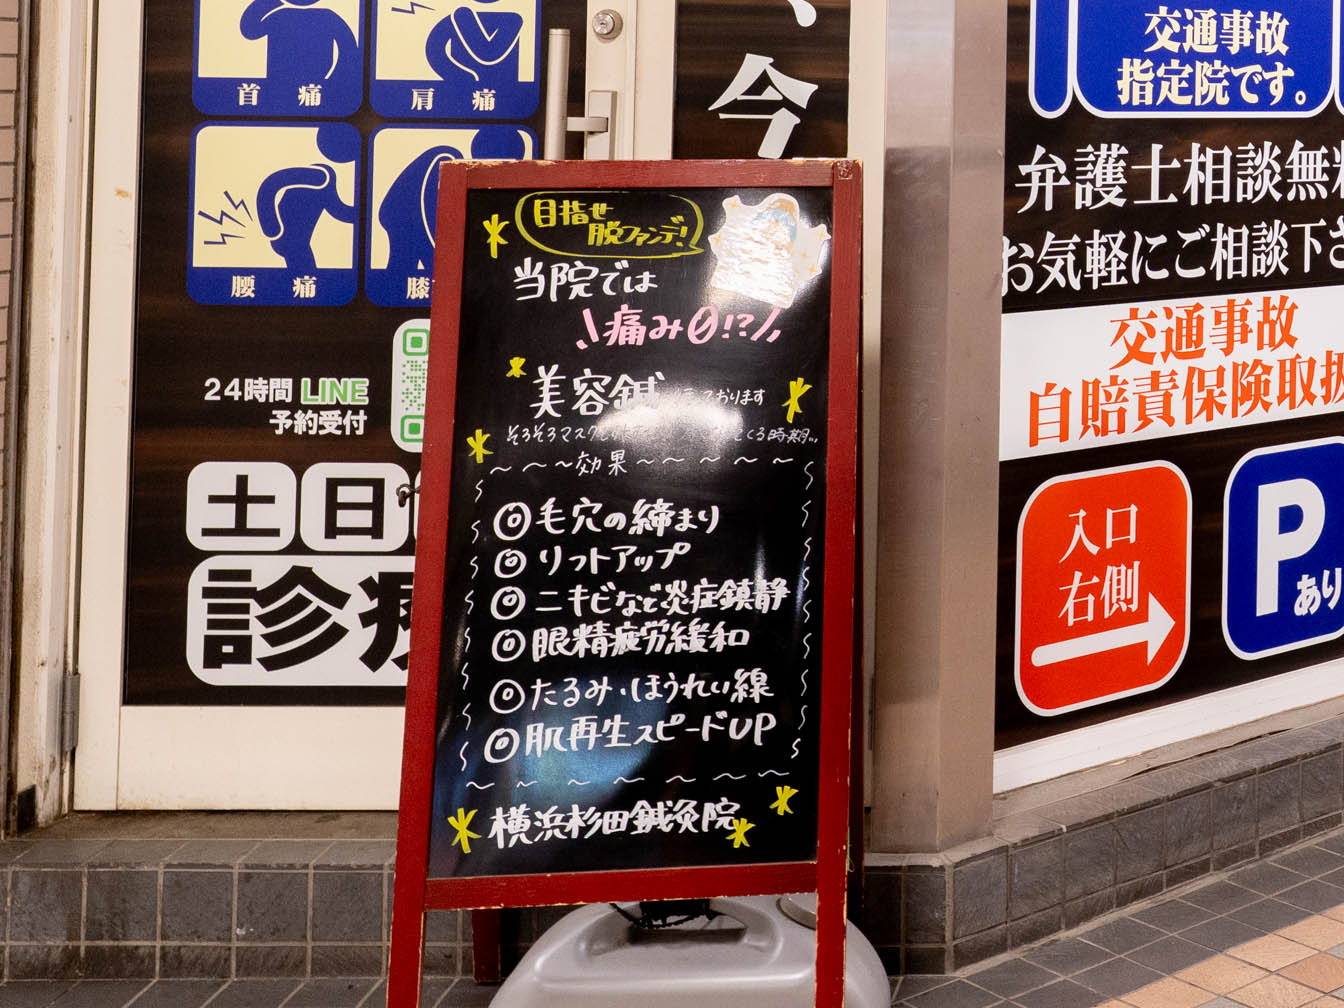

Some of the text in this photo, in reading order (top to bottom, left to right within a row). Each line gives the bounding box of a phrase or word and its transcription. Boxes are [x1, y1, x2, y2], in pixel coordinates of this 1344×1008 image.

[1143, 5, 1289, 56] 交通事故
[1116, 57, 1307, 107] 指定院です。
[533, 199, 615, 228] 目指せ
[513, 257, 658, 303] 当院では
[1108, 294, 1300, 371] 交通事故
[204, 377, 370, 405] 24時間 LINE
[269, 409, 368, 436] 予約受付
[1058, 502, 1138, 565] 入口
[1255, 476, 1343, 617] P あり
[1056, 560, 1141, 628] 右側
[487, 797, 742, 849] 横浜杉田鍼灸院
